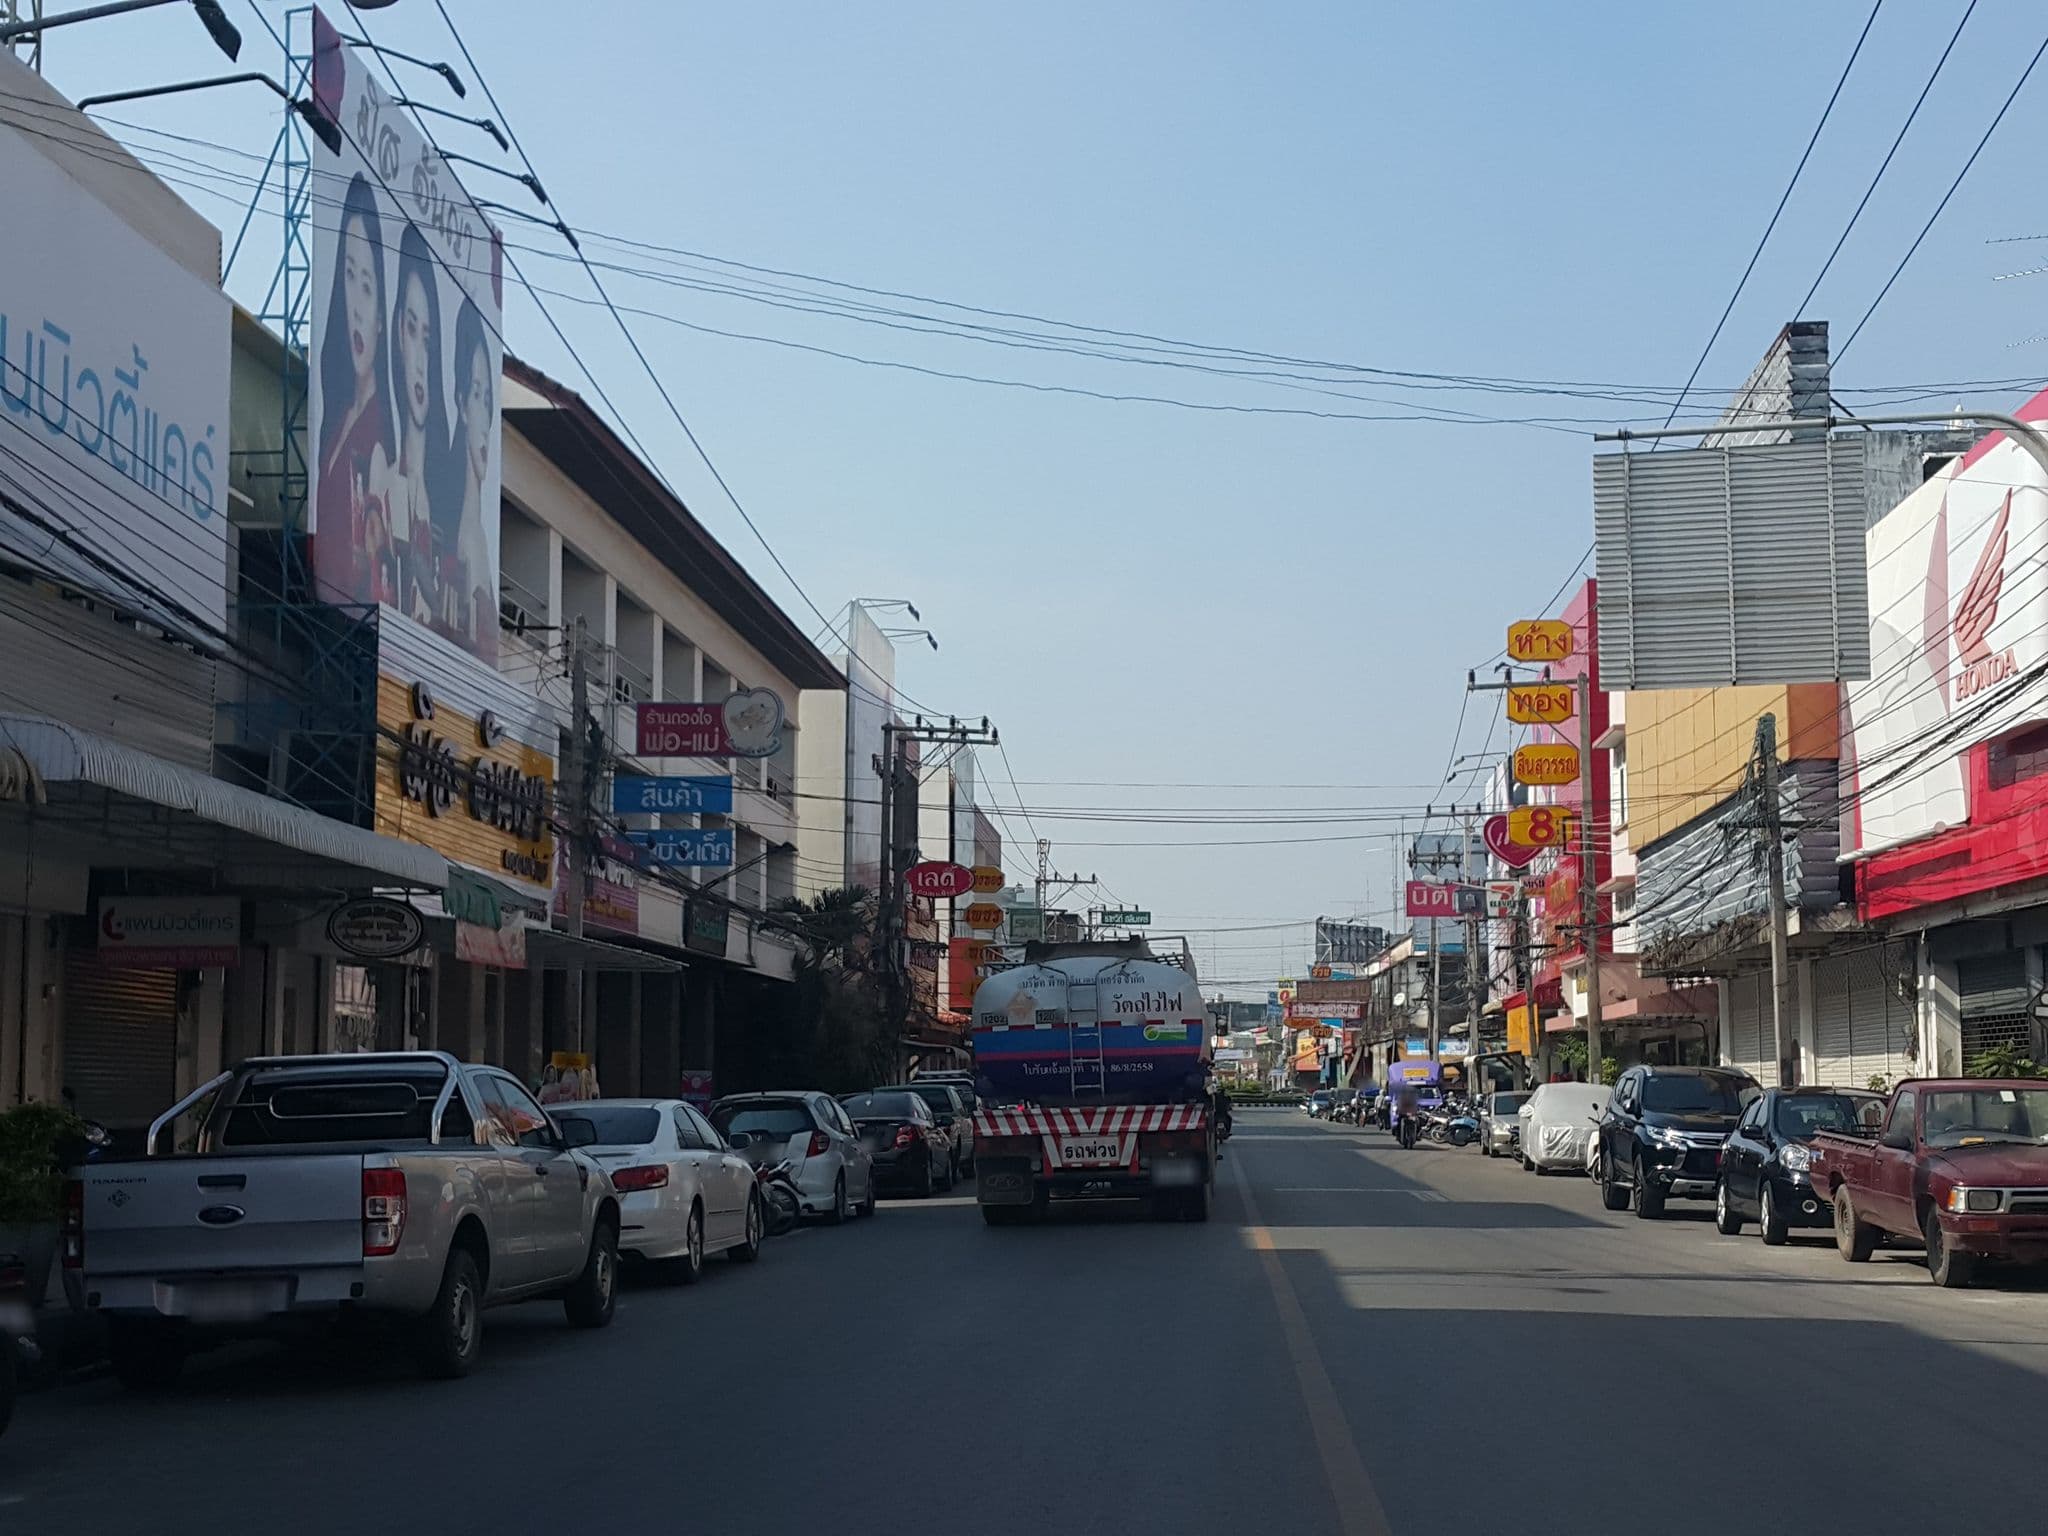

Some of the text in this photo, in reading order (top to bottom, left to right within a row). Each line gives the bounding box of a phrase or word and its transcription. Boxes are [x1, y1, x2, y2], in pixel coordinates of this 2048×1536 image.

[1515, 624, 1568, 654] ห้าง
[1955, 648, 2019, 701] HONDA
[1513, 691, 1568, 713] ทอง
[645, 727, 720, 752] พ่อ-แม่
[640, 781, 703, 808] สินค้า
[1528, 807, 1555, 844] 8
[1112, 991, 1182, 1018] วัตถุไวไฟ
[1064, 1141, 1117, 1159] รถพ่วง
[92, 1176, 147, 1184] RANGER
